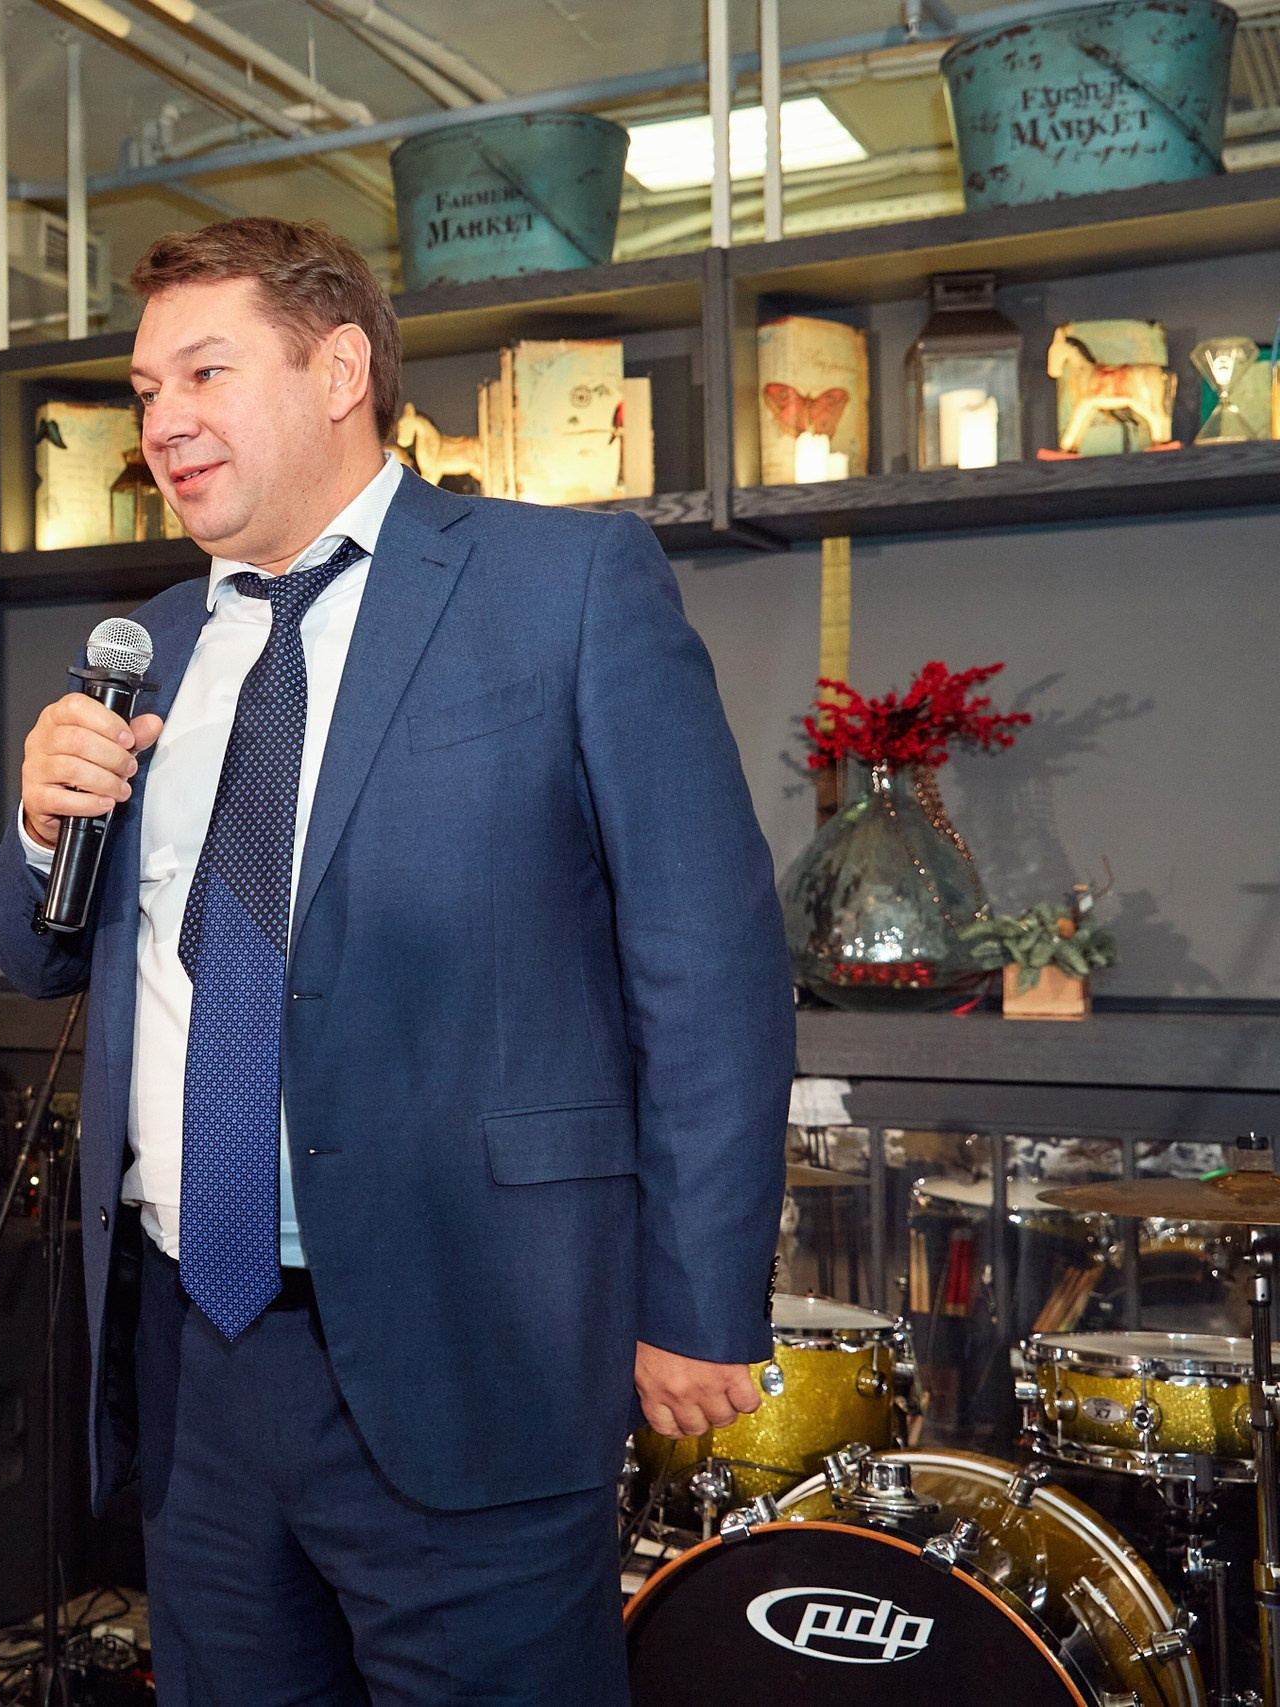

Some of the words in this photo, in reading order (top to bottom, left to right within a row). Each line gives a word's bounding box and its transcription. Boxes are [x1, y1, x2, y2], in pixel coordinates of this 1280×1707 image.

[1010, 109, 1152, 151] MARKET
[426, 212, 537, 249] MARKET
[1093, 1406, 1111, 1419] X7
[793, 1599, 935, 1660] pdp
